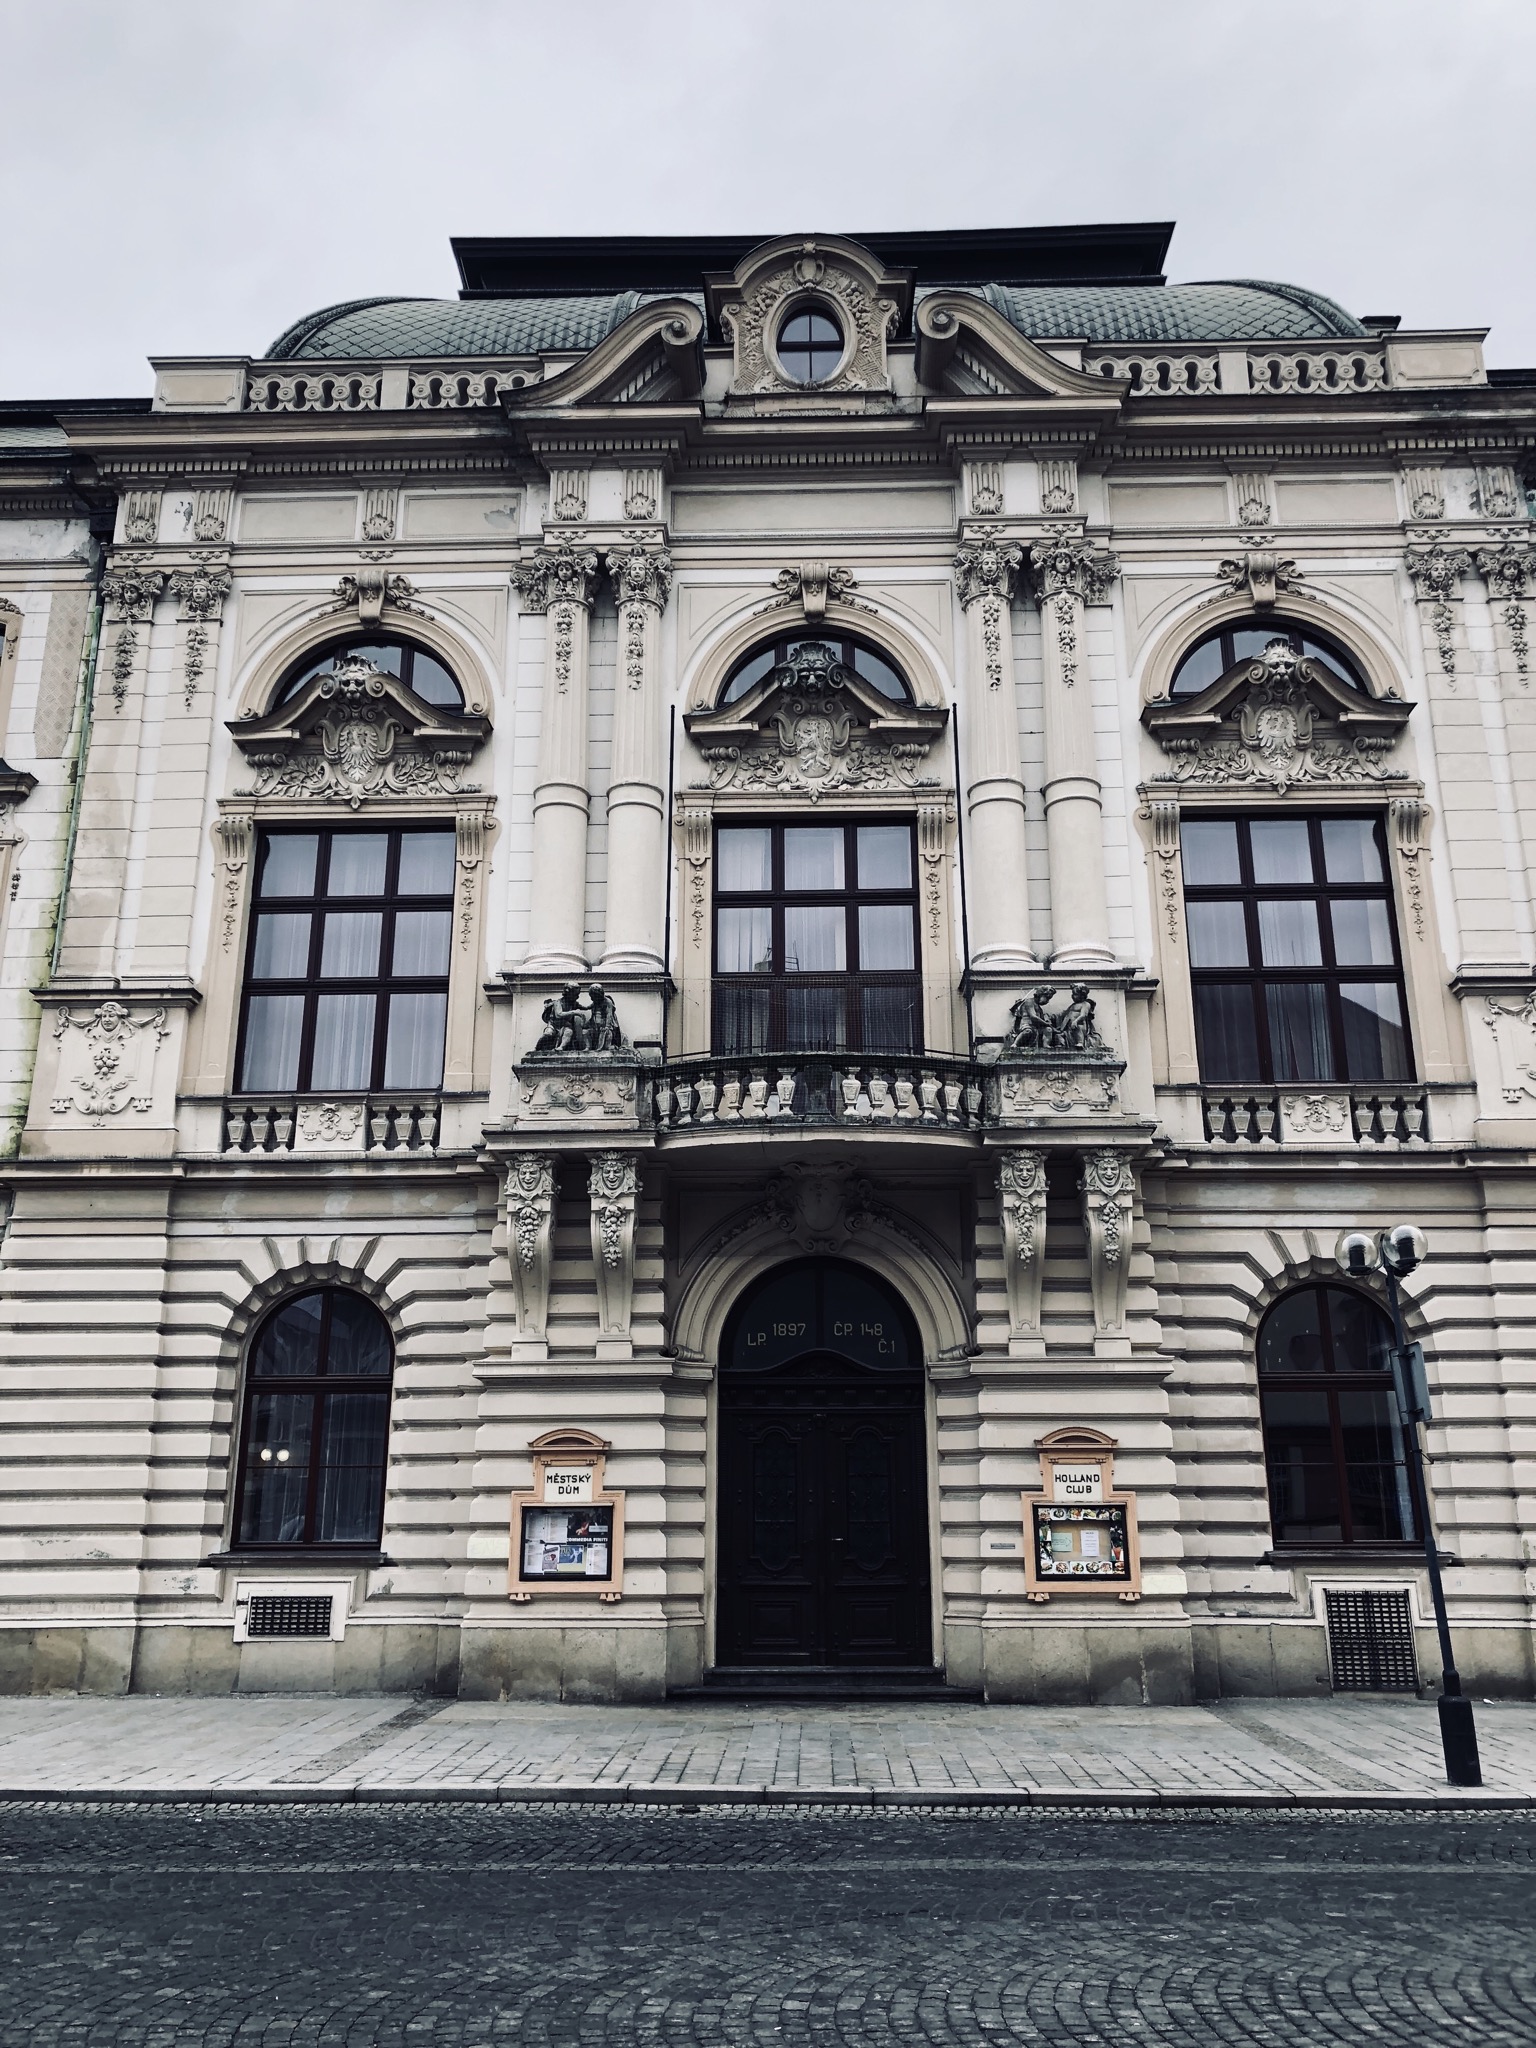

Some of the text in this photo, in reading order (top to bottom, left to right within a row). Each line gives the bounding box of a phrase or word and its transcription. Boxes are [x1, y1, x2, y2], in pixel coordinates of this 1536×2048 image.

[773, 1323, 807, 1336] 1897
[860, 1323, 883, 1336] 148
[546, 1473, 591, 1484] MĚSTSKÝ
[1054, 1474, 1100, 1483] HOLLAND
[558, 1485, 580, 1494] DŮM
[1065, 1485, 1092, 1494] CLUB
